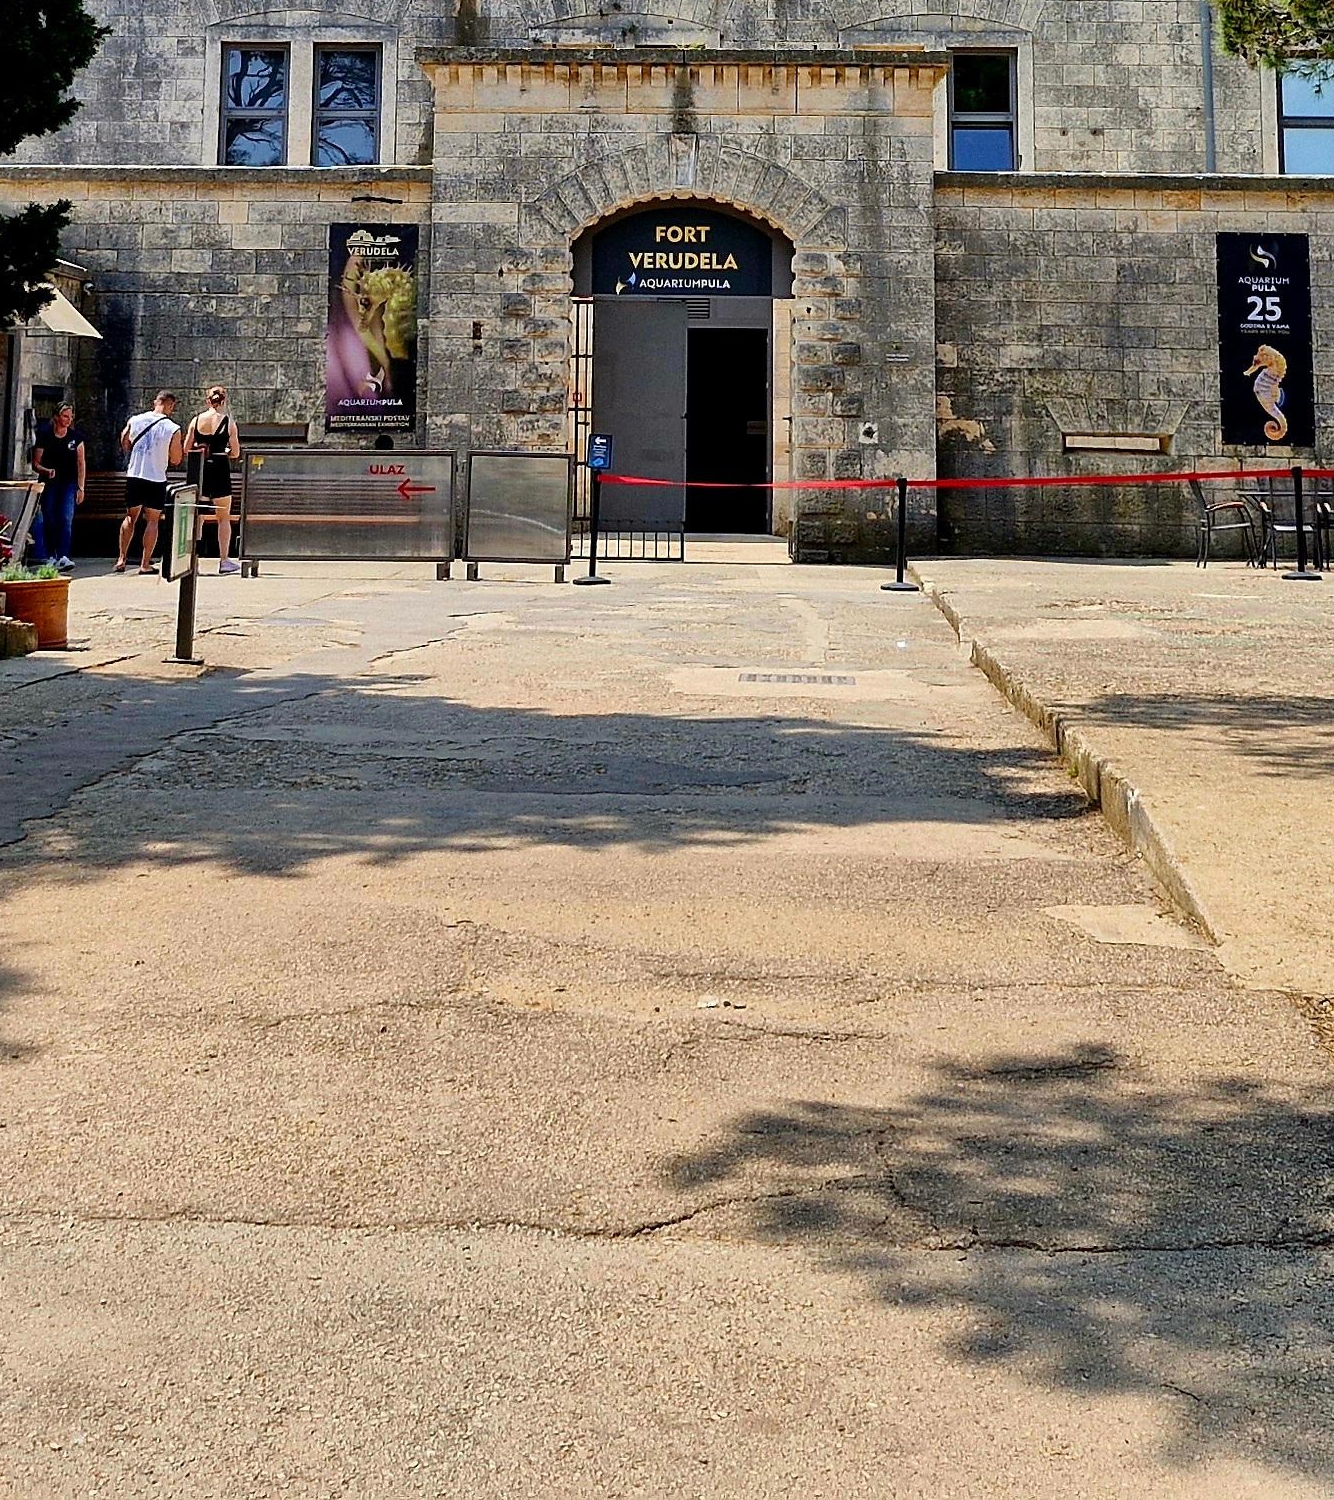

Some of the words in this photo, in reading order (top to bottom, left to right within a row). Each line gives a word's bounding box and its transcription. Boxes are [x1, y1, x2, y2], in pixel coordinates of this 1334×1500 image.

[655, 225, 711, 243] FORT
[347, 246, 400, 256] VERUDELA
[628, 251, 739, 270] VERUDELA
[639, 278, 731, 289] AQUARIUMPULA
[1238, 276, 1290, 285] AQUARIUM
[1251, 284, 1278, 292] PULA
[1247, 295, 1282, 322] 25
[337, 398, 404, 407] AQUARIUMPULA
[369, 464, 406, 475] ULAZ
